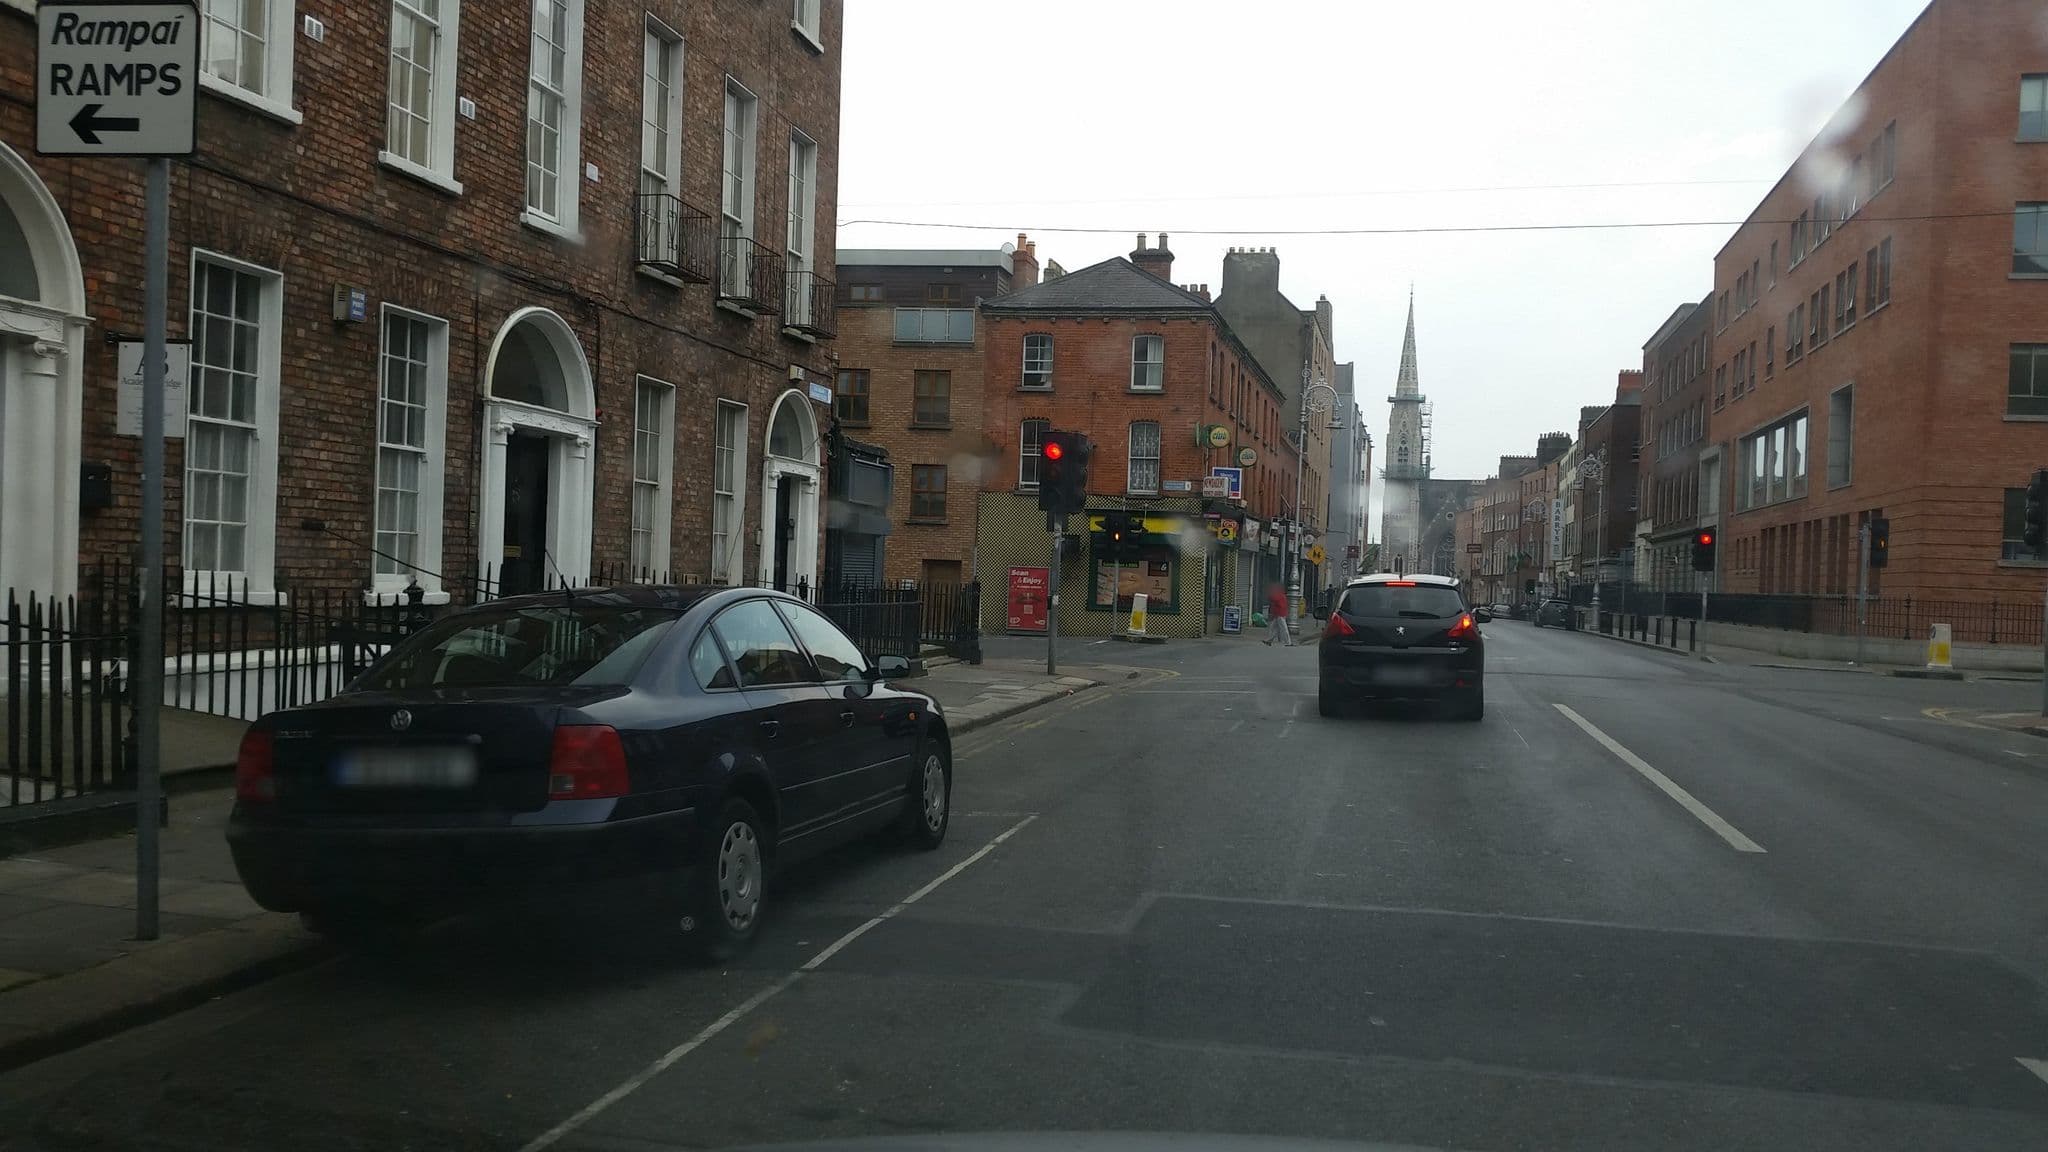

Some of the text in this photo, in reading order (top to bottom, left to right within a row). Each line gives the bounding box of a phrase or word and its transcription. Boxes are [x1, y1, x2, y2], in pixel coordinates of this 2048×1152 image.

[51, 12, 185, 53] Rampaí
[50, 62, 182, 97] RAMPS
[1022, 577, 1043, 585] Enjoy
